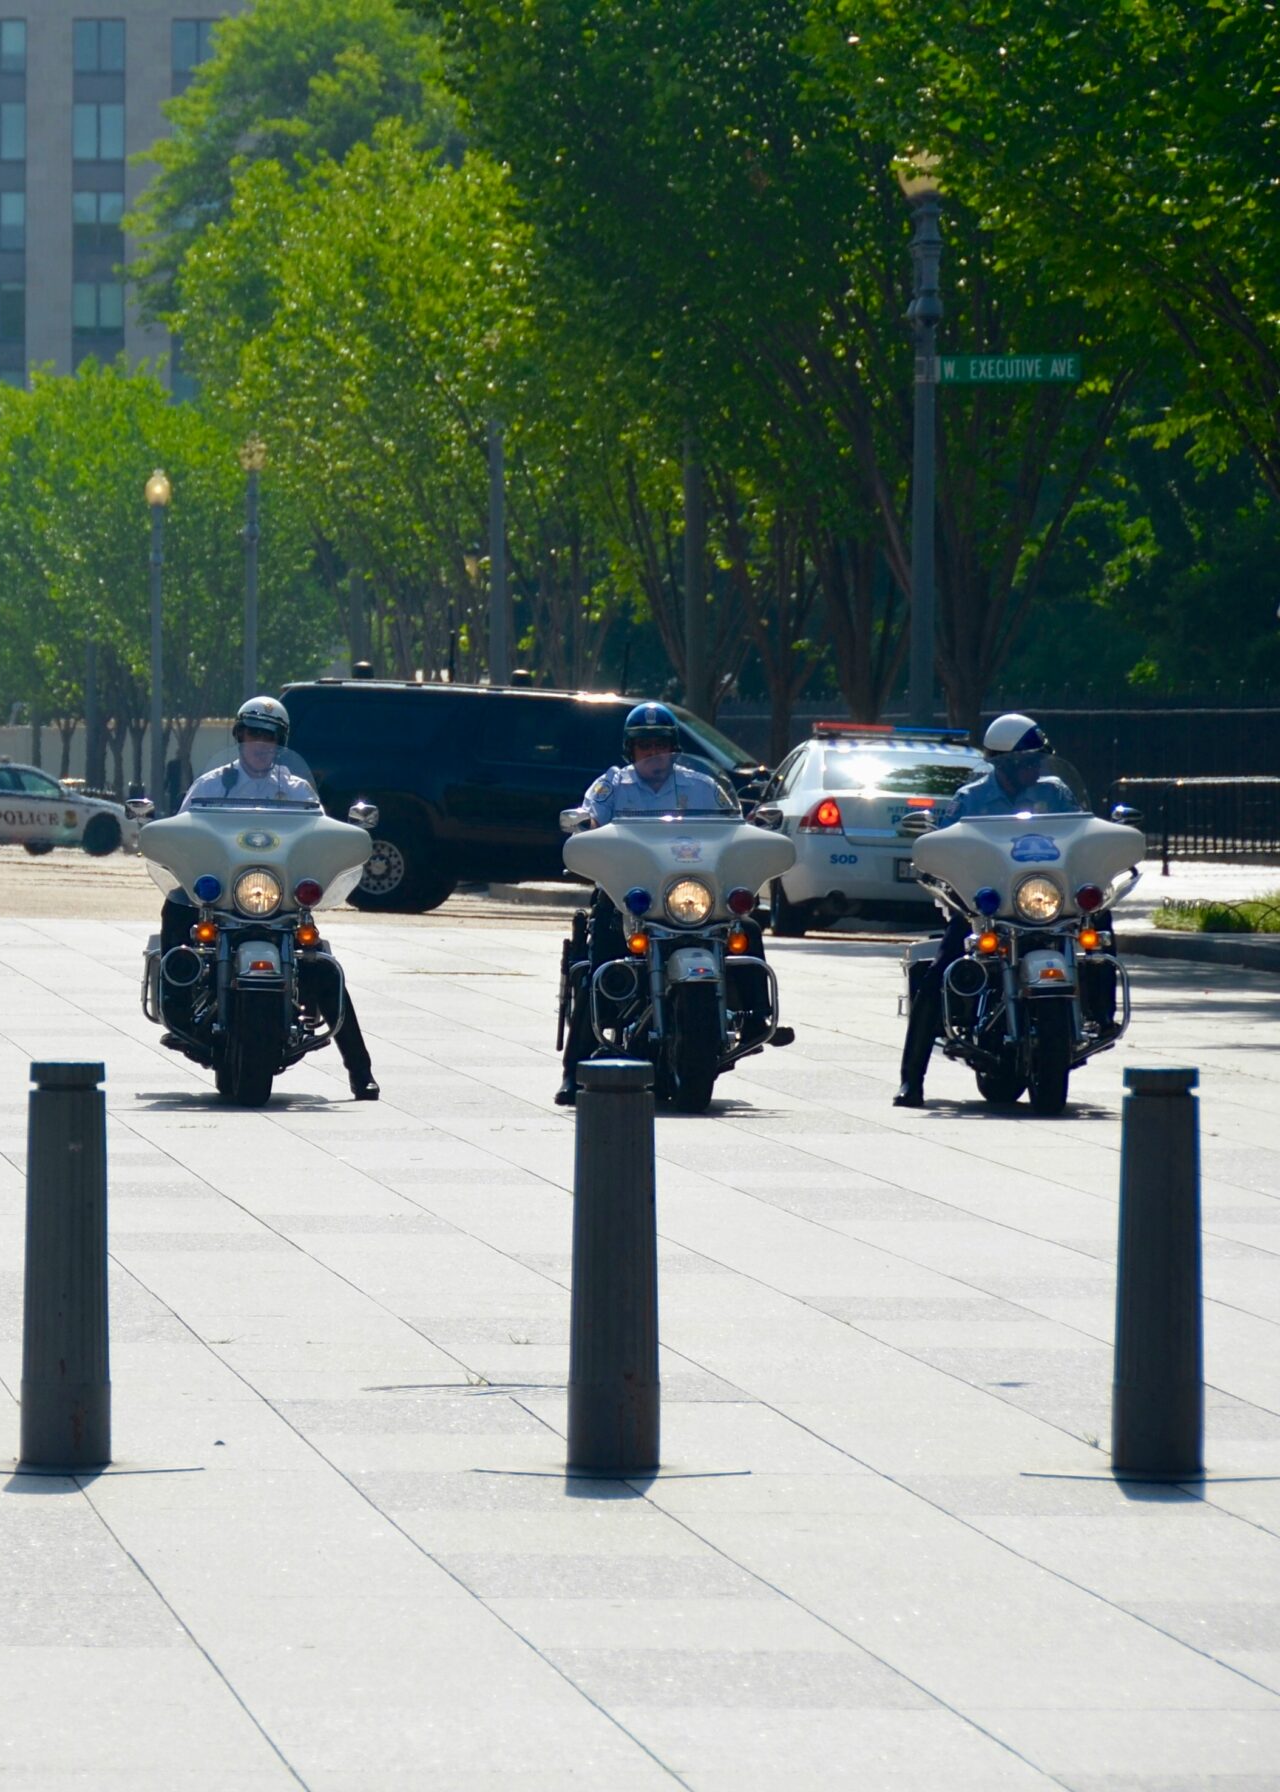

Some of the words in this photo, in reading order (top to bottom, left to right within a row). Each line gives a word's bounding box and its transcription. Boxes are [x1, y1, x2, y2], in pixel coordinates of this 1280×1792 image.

[970, 359, 1042, 379] EXECUTIVE
[1050, 358, 1075, 378] AVE
[830, 854, 858, 865] SOD
